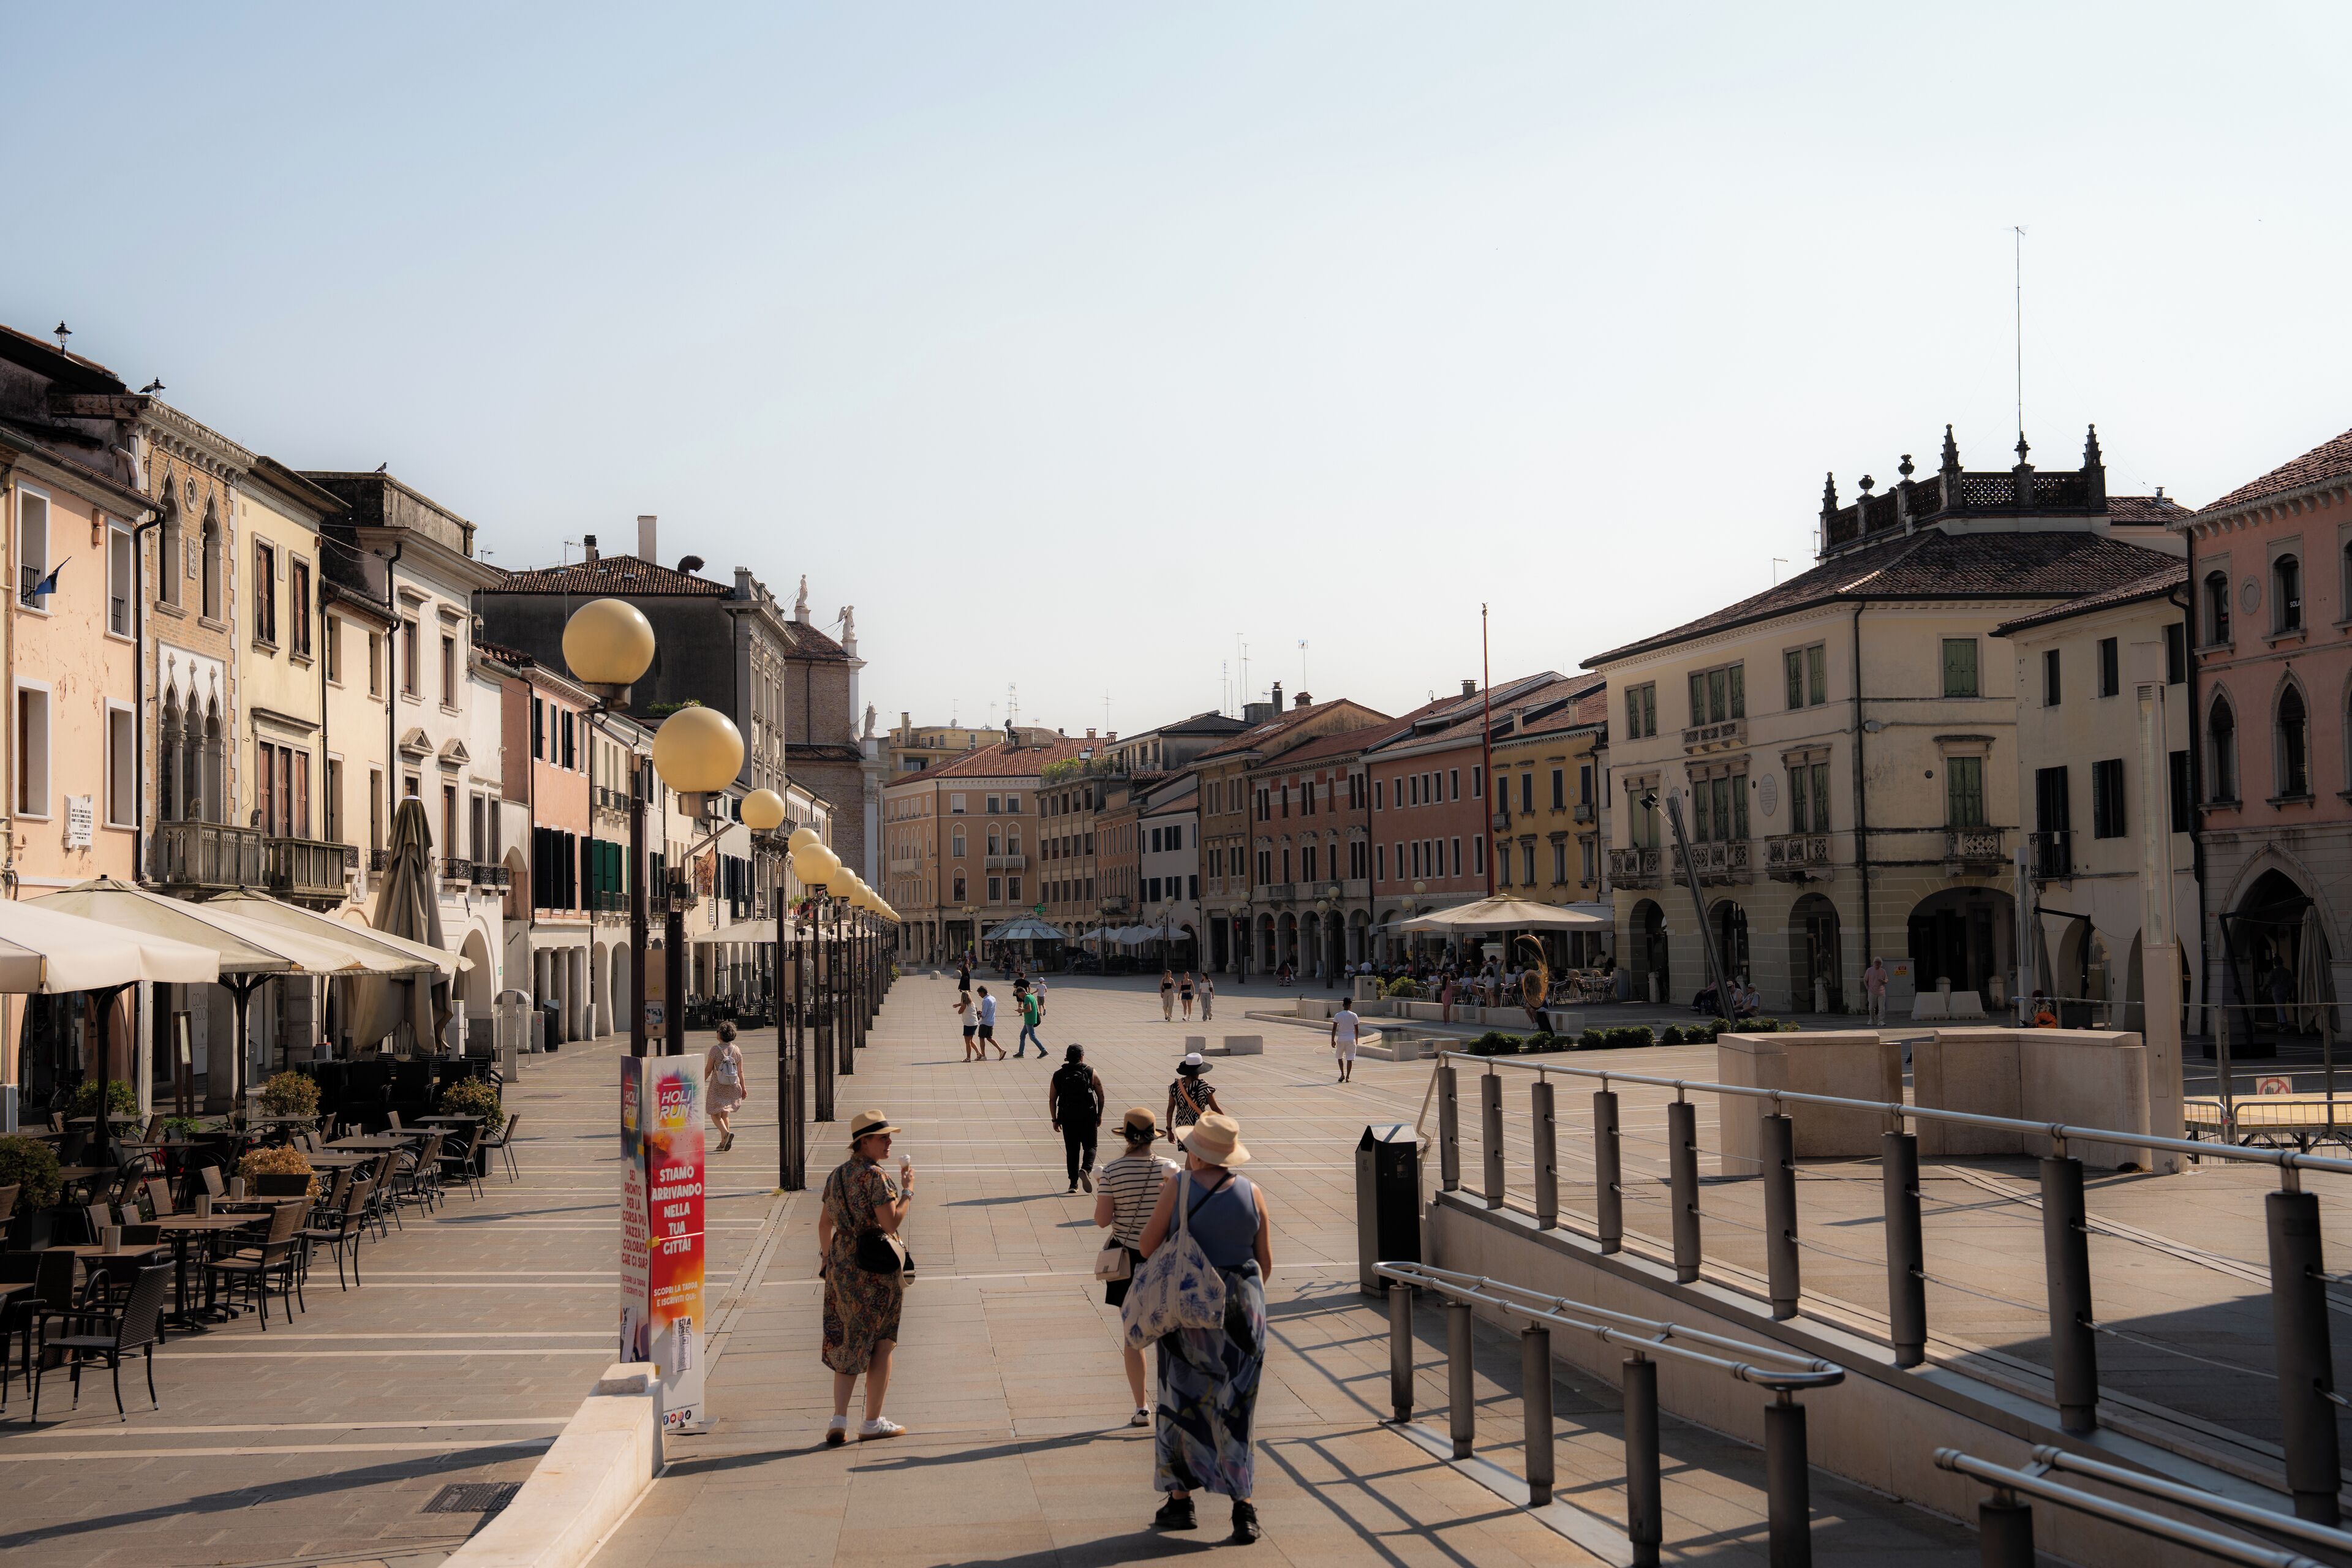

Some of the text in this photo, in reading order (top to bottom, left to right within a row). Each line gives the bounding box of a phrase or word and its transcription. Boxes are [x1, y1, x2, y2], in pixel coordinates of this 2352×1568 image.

[625, 1090, 638, 1104] HOLI
[662, 1089, 692, 1104] HOLI
[624, 1104, 638, 1120] RUN
[659, 1103, 690, 1120] RUN
[660, 1166, 695, 1183] STIAMO
[625, 1182, 641, 1197] PRONTO
[650, 1183, 702, 1202] ARRIVANDO
[635, 1199, 641, 1211] LA
[664, 1202, 690, 1218] NELLA
[622, 1210, 638, 1224] CORSA
[625, 1224, 645, 1240] PAZZA E
[668, 1221, 686, 1236] TUA
[623, 1238, 647, 1255] COLORATA
[663, 1237, 691, 1255] CITTÀ!
[622, 1253, 648, 1270] CHE CI SIA?
[622, 1274, 632, 1283] SCOPRI
[637, 1278, 646, 1287] TAPPA
[654, 1281, 698, 1297] SCOPRI LA TAPPA
[662, 1296, 684, 1306] ISCRIVITI
